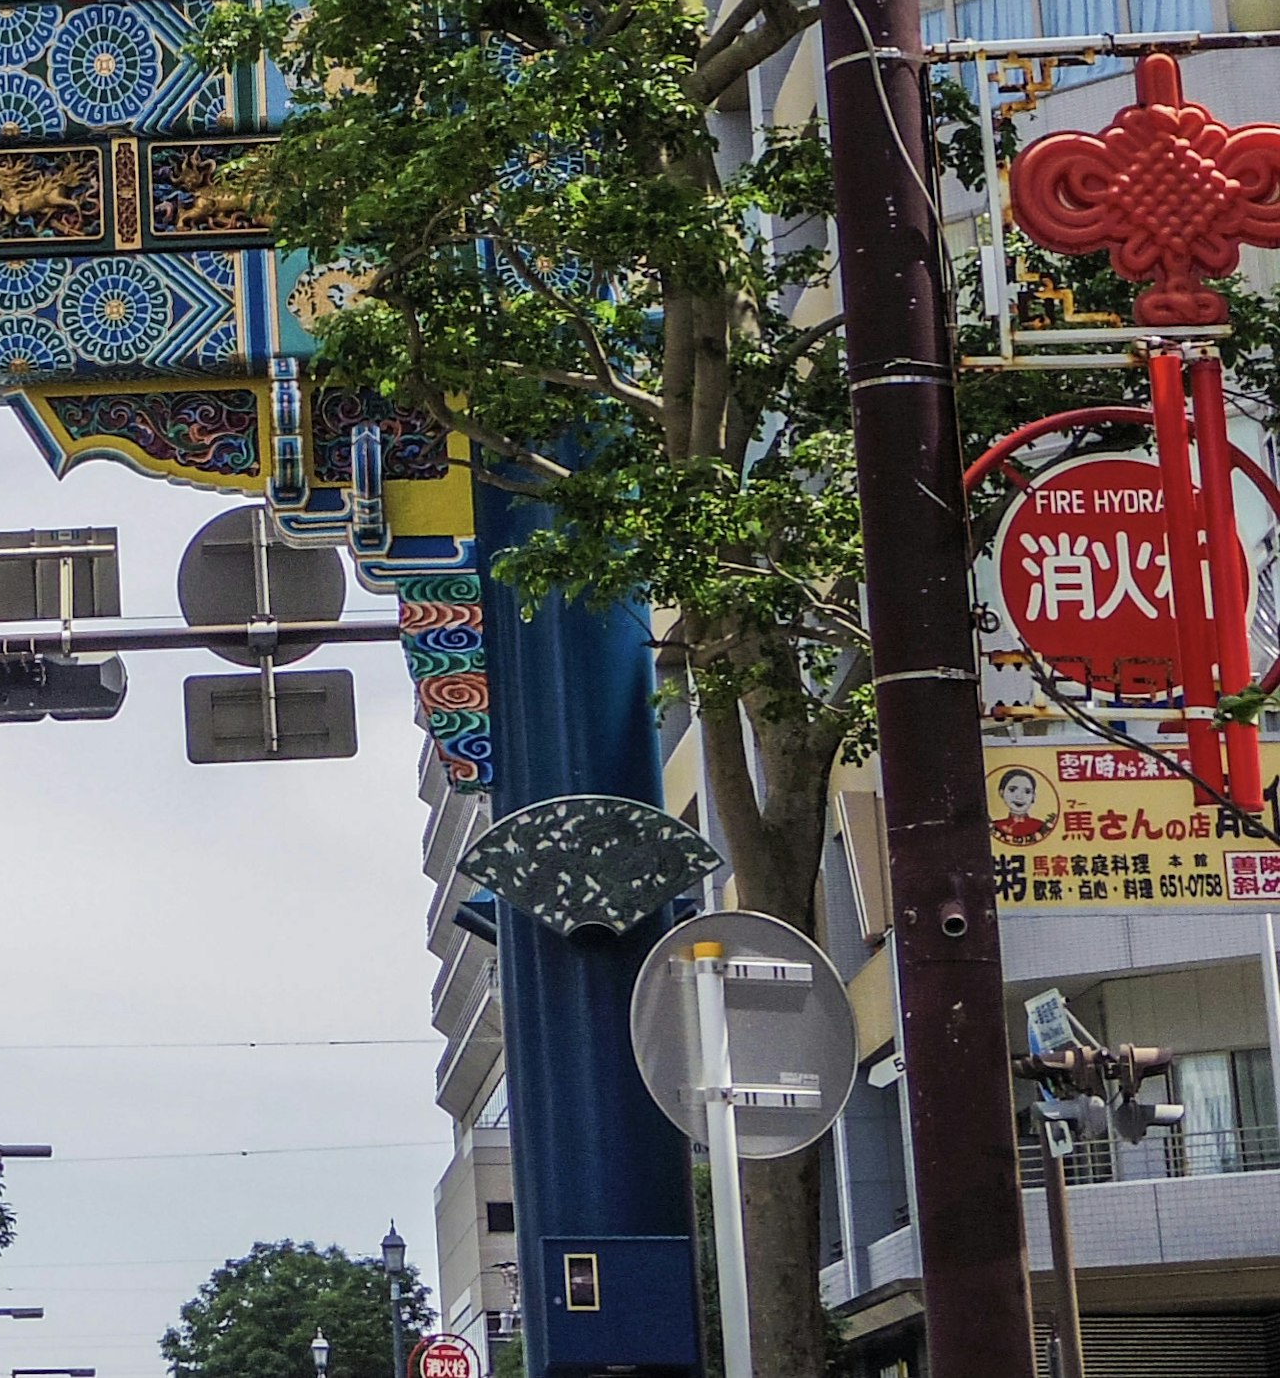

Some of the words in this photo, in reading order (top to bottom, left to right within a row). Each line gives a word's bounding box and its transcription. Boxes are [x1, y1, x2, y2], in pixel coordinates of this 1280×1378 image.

[1035, 489, 1085, 514] FIRE
[1062, 808, 1211, 841] 馬さんの店
[1160, 874, 1223, 898] 651-0758
